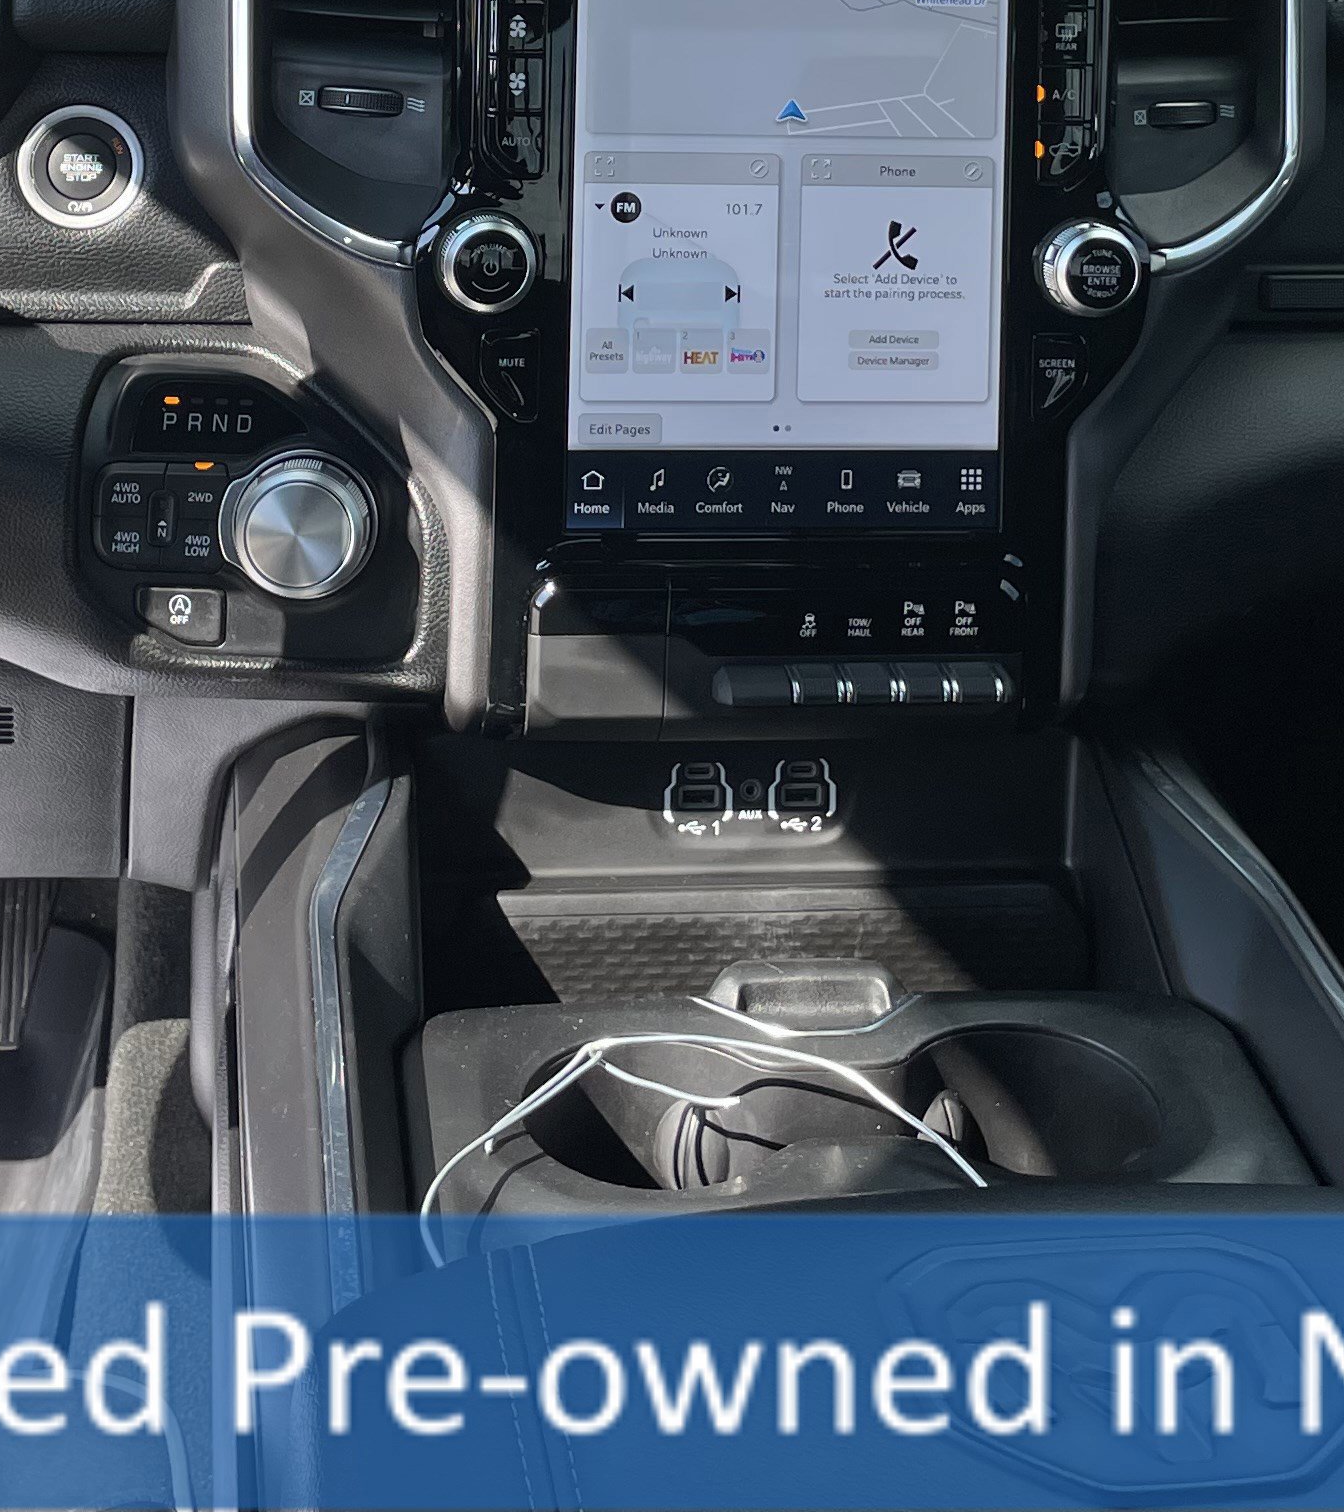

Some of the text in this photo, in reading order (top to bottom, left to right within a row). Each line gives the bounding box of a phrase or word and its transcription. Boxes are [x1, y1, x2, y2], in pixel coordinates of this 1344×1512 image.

[1055, 42, 1077, 51] REAR
[1052, 88, 1077, 101] A/C
[501, 136, 530, 147] AUTO
[63, 153, 100, 162] START
[60, 162, 103, 172] ENGINE
[879, 165, 916, 177] Phone
[65, 173, 97, 182] STOP
[616, 202, 635, 213] FM
[726, 203, 763, 216] 101.7
[652, 227, 708, 239] Unknown
[652, 248, 708, 259] Unknown
[1092, 249, 1113, 258] TUNE
[1083, 265, 1121, 274] BROWSE
[833, 273, 869, 284] Select
[946, 274, 958, 285] to
[1087, 276, 1117, 286] ENTER
[824, 288, 966, 301] start the pairing process.
[1087, 288, 1116, 298] SCROLL
[601, 341, 613, 350] All
[868, 335, 919, 345] Add Device
[498, 357, 525, 368] MUTE
[589, 352, 624, 362] Presets
[683, 351, 719, 365] HEAT
[858, 356, 930, 367] Device Manager
[1038, 358, 1076, 368] SCREEN
[1045, 369, 1065, 378] OFF
[589, 424, 651, 437] Edit Pages
[775, 466, 793, 476] NW
[112, 482, 140, 492] 4WD
[111, 492, 141, 503] AUTO
[187, 491, 214, 503] 2WD
[574, 502, 610, 514] Home
[637, 502, 675, 515] Media
[695, 501, 743, 514] Comfort
[770, 502, 795, 514] Nav
[827, 501, 864, 514] Phone
[886, 501, 930, 514] Vehicle
[956, 502, 986, 516] Apps
[113, 531, 140, 542] 4WD
[157, 527, 167, 538] N
[184, 535, 211, 546] 4WD
[111, 542, 140, 554] HIGH
[184, 546, 210, 557] LOW
[169, 614, 189, 625] OFF
[848, 618, 873, 627] TOW/
[904, 617, 922, 626] OFF
[955, 616, 973, 626] OFF
[799, 628, 817, 638] OFF
[847, 628, 872, 638] HAUL
[901, 627, 925, 636] REAR
[949, 627, 979, 636] FRONT
[737, 809, 763, 820] AUX
[711, 820, 721, 836] 1
[810, 815, 822, 832] 2
